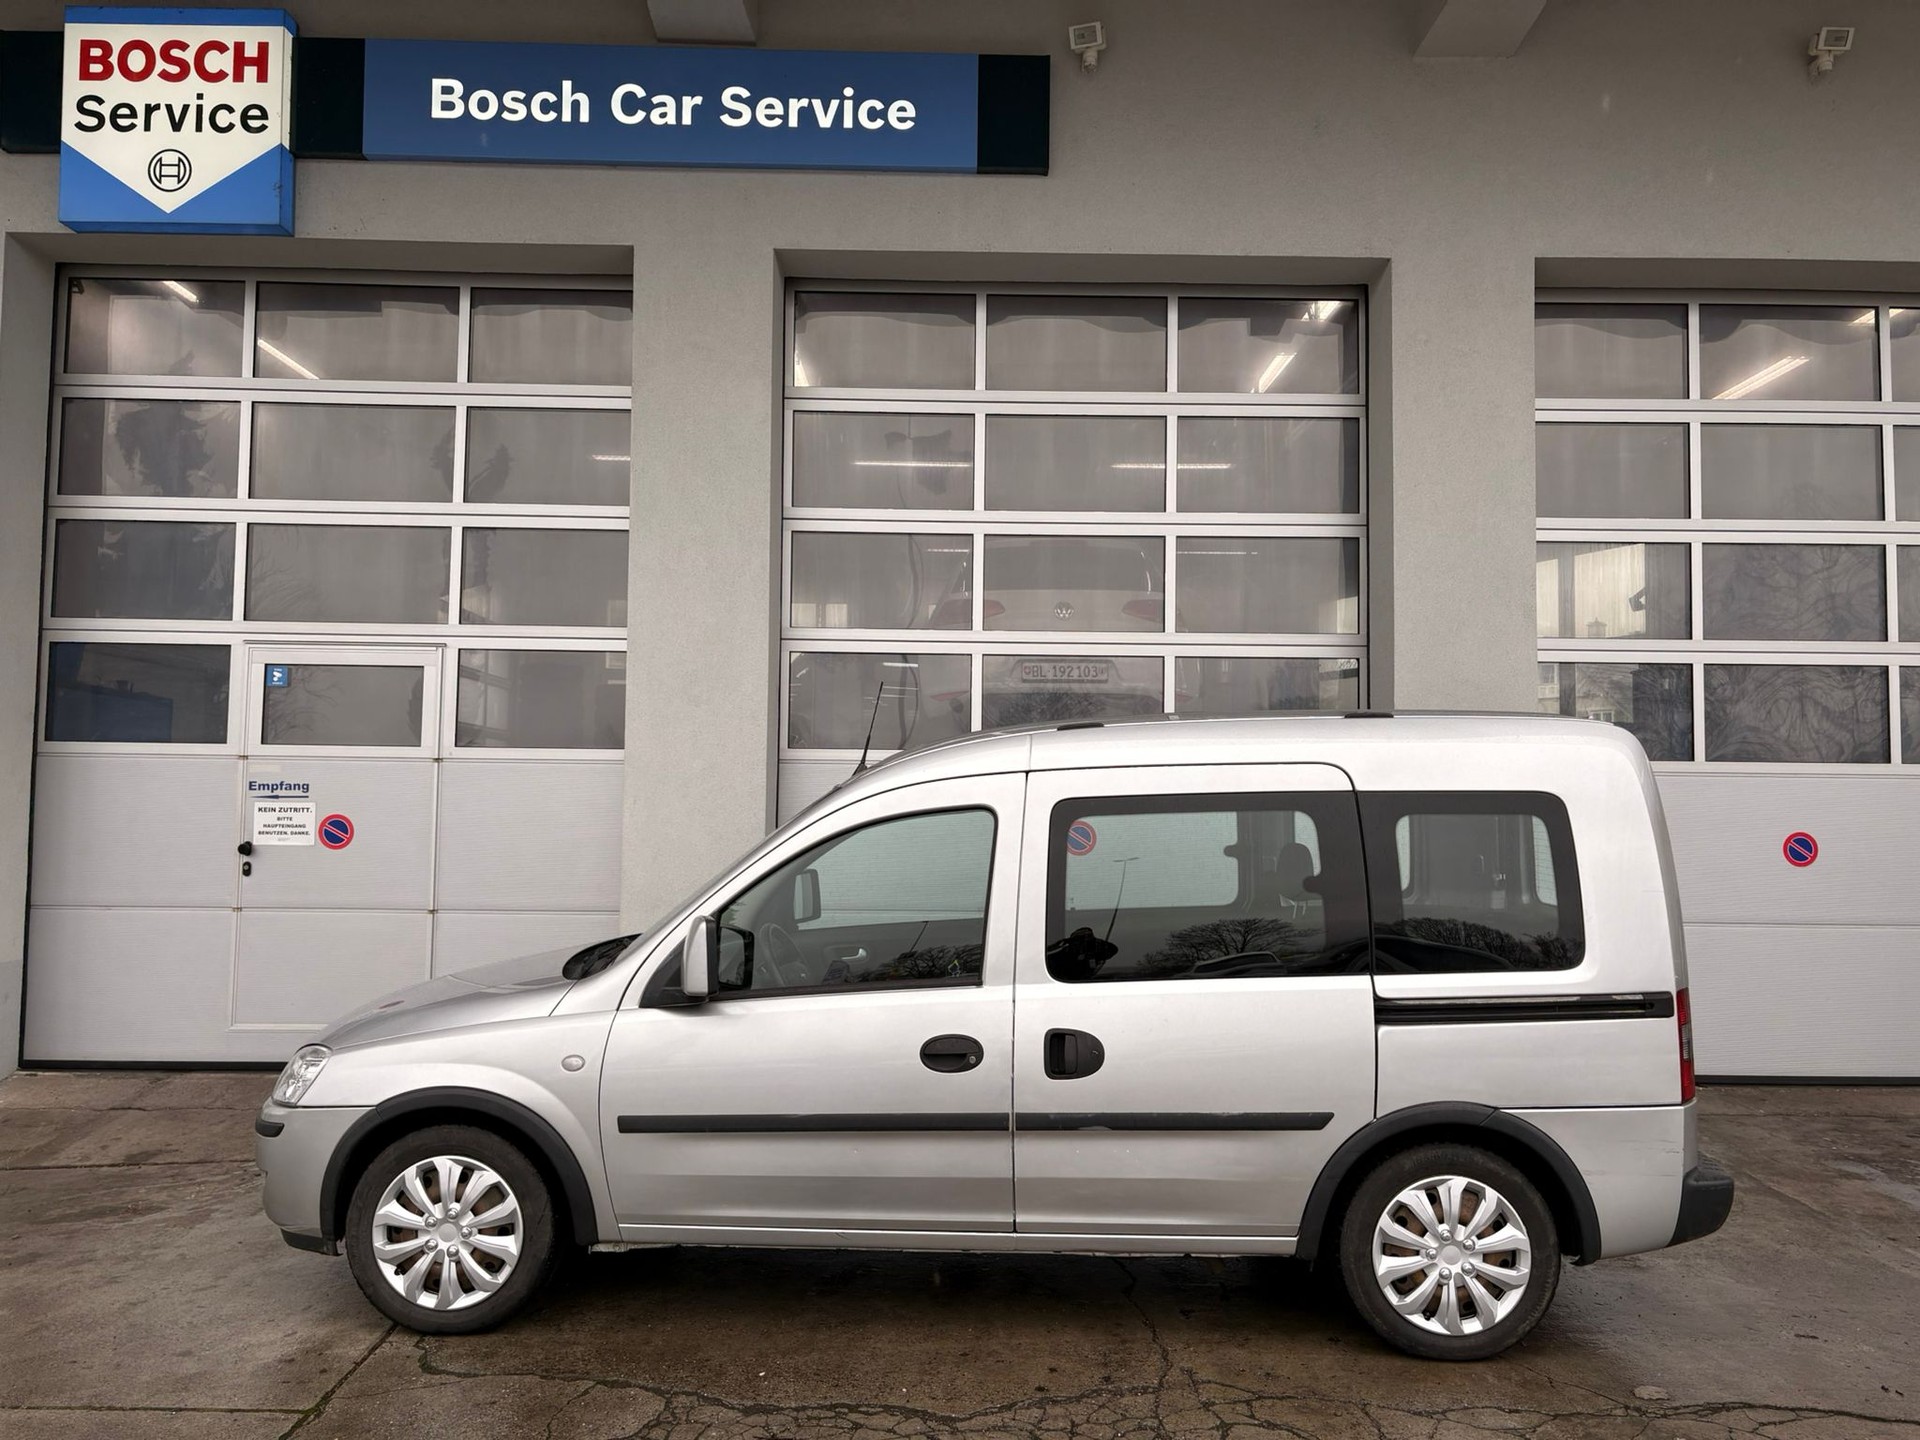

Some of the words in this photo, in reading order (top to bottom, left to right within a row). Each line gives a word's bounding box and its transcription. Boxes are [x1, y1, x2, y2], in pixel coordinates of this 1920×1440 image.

[78, 39, 270, 84] BOSCH
[74, 93, 270, 134] Service
[431, 78, 590, 123] Bosch
[610, 83, 704, 126] Car
[719, 86, 917, 131] Service
[248, 781, 310, 793] Empfang
